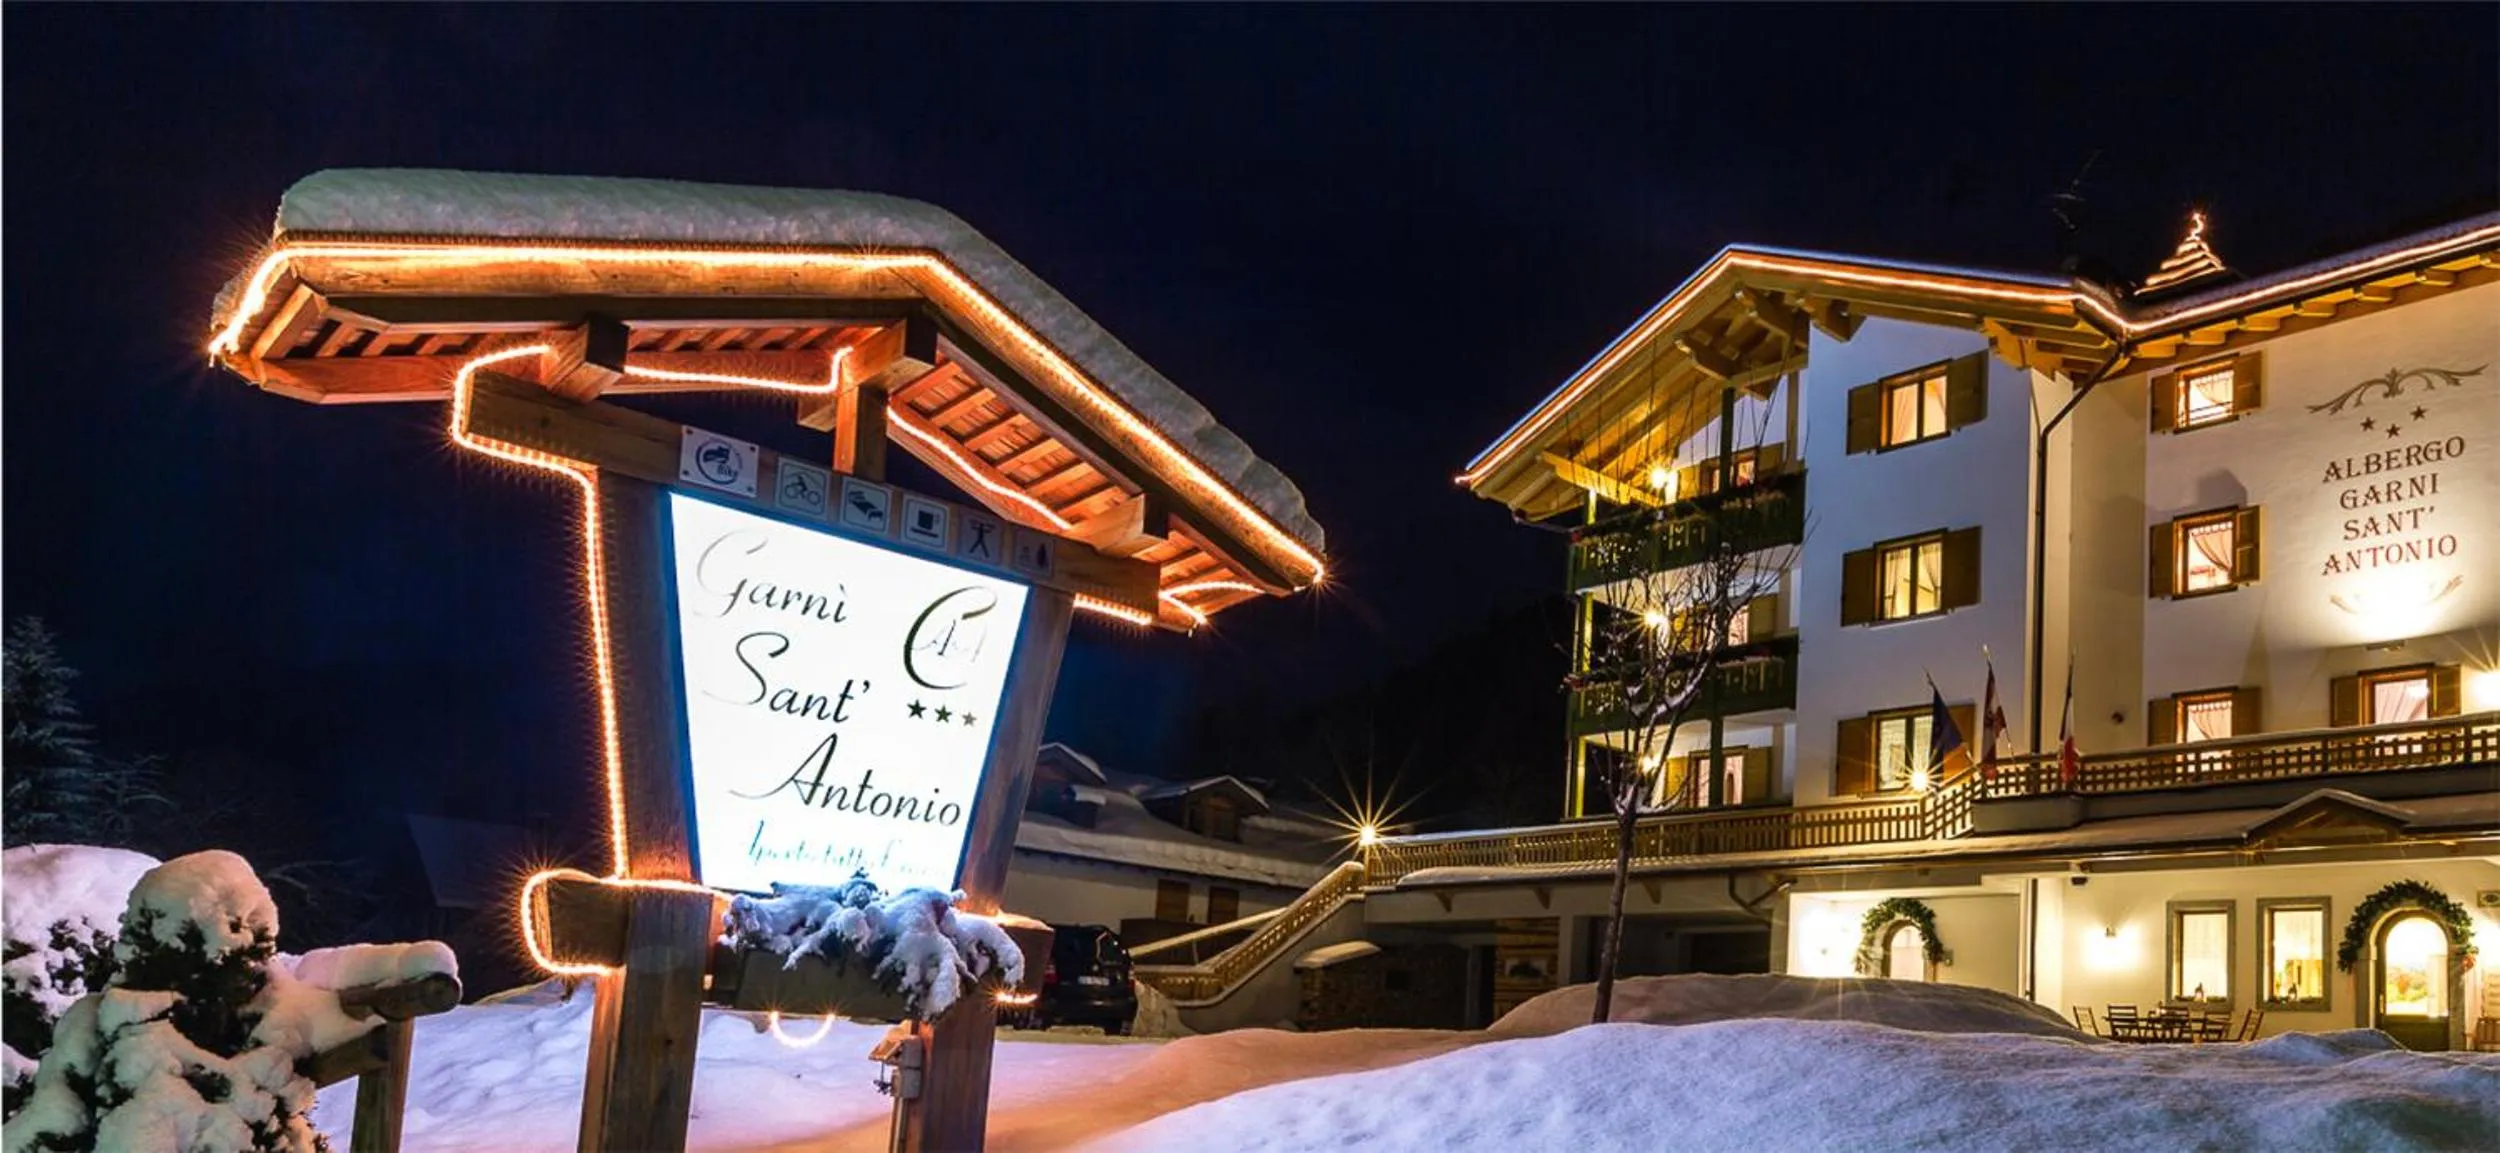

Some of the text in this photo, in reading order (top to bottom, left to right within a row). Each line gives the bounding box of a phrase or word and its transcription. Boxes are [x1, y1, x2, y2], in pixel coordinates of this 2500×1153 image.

[2322, 435, 2466, 483] ALBERGO
[2339, 472, 2441, 511] GARNI
[2343, 505, 2436, 541] SANT'
[694, 528, 849, 625] Garnì
[2321, 534, 2458, 576] ANTONIO
[701, 629, 872, 725] Sant'
[727, 731, 962, 828] Antonio
